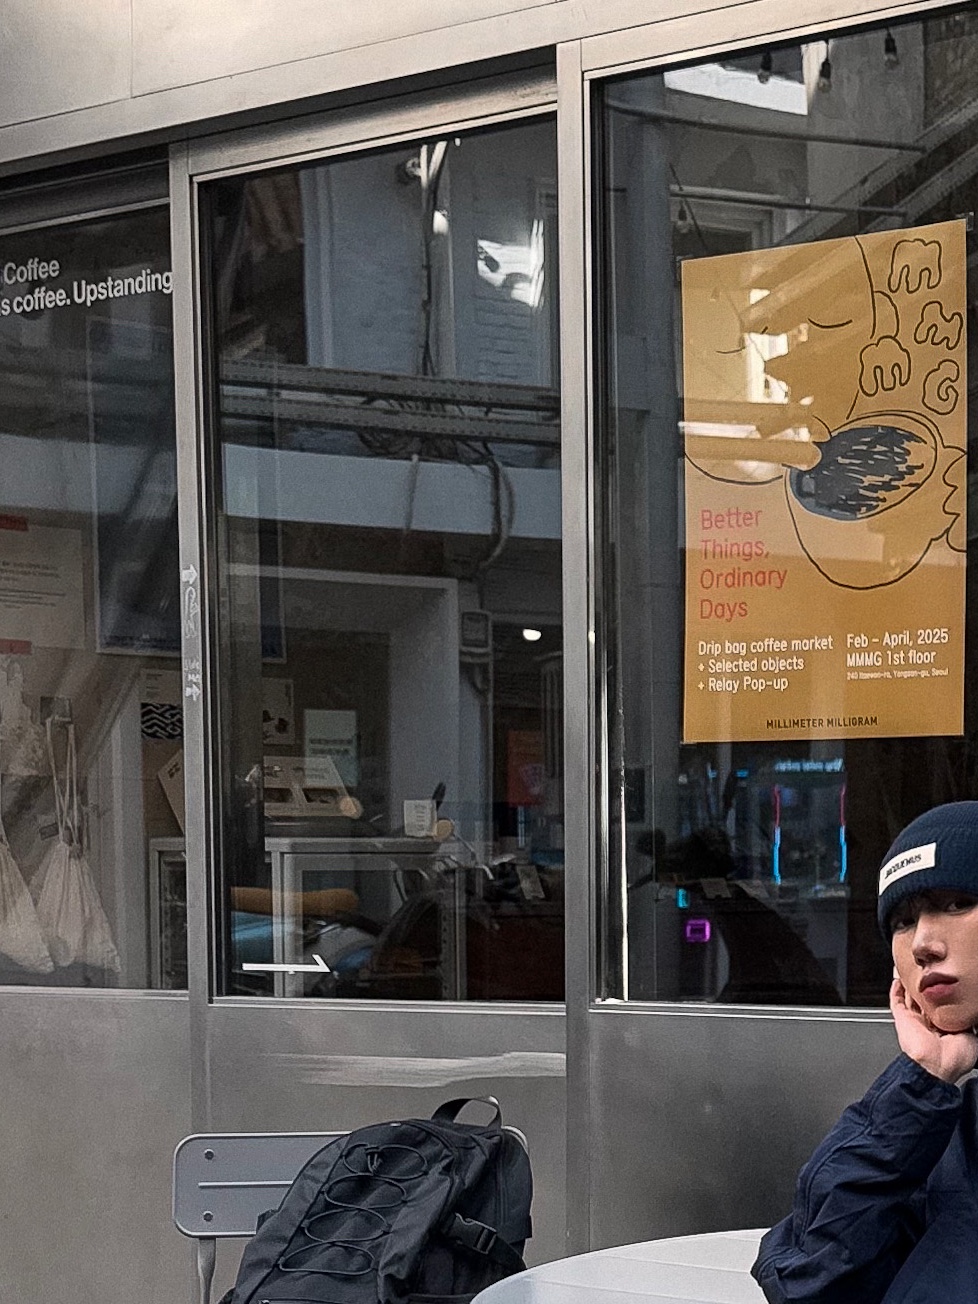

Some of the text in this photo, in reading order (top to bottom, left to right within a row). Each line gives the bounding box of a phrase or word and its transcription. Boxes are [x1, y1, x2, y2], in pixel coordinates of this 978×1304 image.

[3, 257, 60, 285] Coffee
[12, 286, 71, 314] coffee.
[73, 268, 174, 307] Upstanding
[701, 506, 763, 530] Better
[701, 538, 770, 562] Things,
[700, 566, 788, 590] Ordinary
[700, 598, 748, 622] Days
[698, 634, 834, 657] Drip bag coffee market
[846, 633, 869, 649] Feb
[883, 630, 914, 649] April,
[917, 628, 949, 645] 2025
[708, 657, 758, 673] Selected
[761, 655, 805, 674] objects
[846, 649, 937, 667] MMMG 1st floor
[708, 677, 739, 694] Relay
[743, 675, 789, 693] Pop-up
[766, 717, 879, 730] MILLIMETER MILLIGRAM
